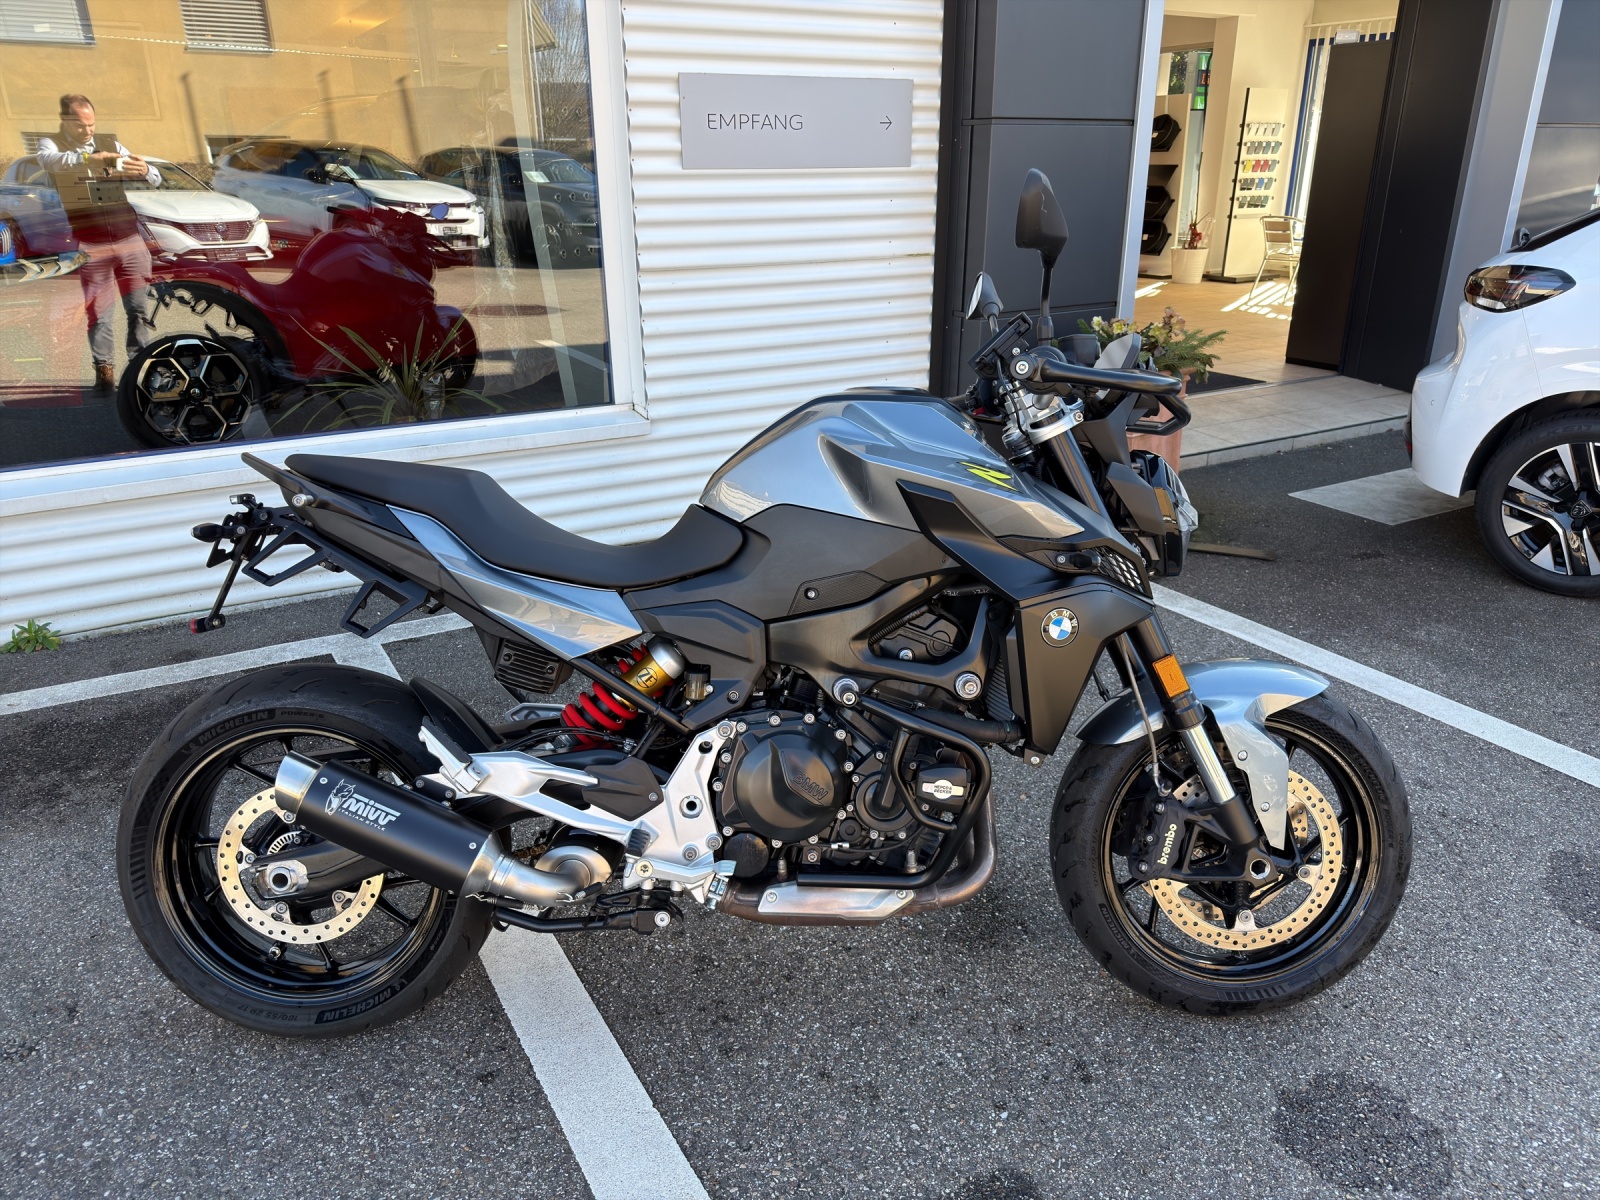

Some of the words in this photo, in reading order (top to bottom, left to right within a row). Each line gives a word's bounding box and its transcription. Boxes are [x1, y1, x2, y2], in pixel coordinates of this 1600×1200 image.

[706, 113, 804, 131] EMPFANG
[1050, 610, 1078, 627] BMW
[637, 667, 658, 689] ZF
[198, 711, 270, 744] MICHELIN
[280, 710, 316, 718] POWER
[792, 773, 829, 800] BMW
[338, 808, 365, 822] ITALIAN
[365, 820, 386, 831] STYLE
[1157, 823, 1177, 865] brembo
[1101, 906, 1130, 950] MICHELIN
[265, 1011, 298, 1022] 180/55
[323, 988, 392, 1021] MICHELIN
